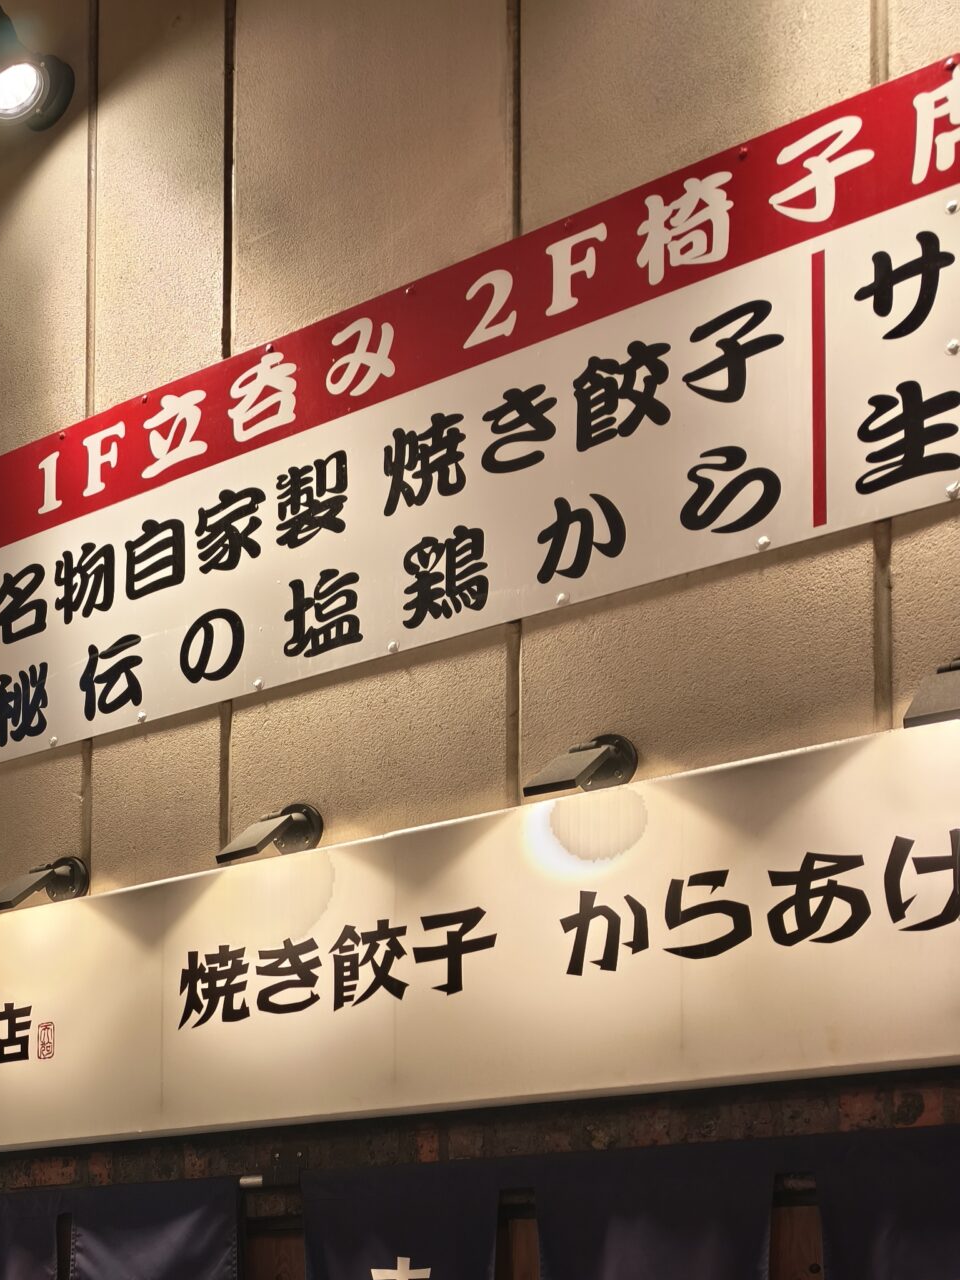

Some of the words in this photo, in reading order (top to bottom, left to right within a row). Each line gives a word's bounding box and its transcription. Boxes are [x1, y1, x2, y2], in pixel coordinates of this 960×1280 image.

[854, 231, 956, 339] サ
[855, 380, 960, 495] 生
[178, 907, 497, 1030] 焼き餃子
